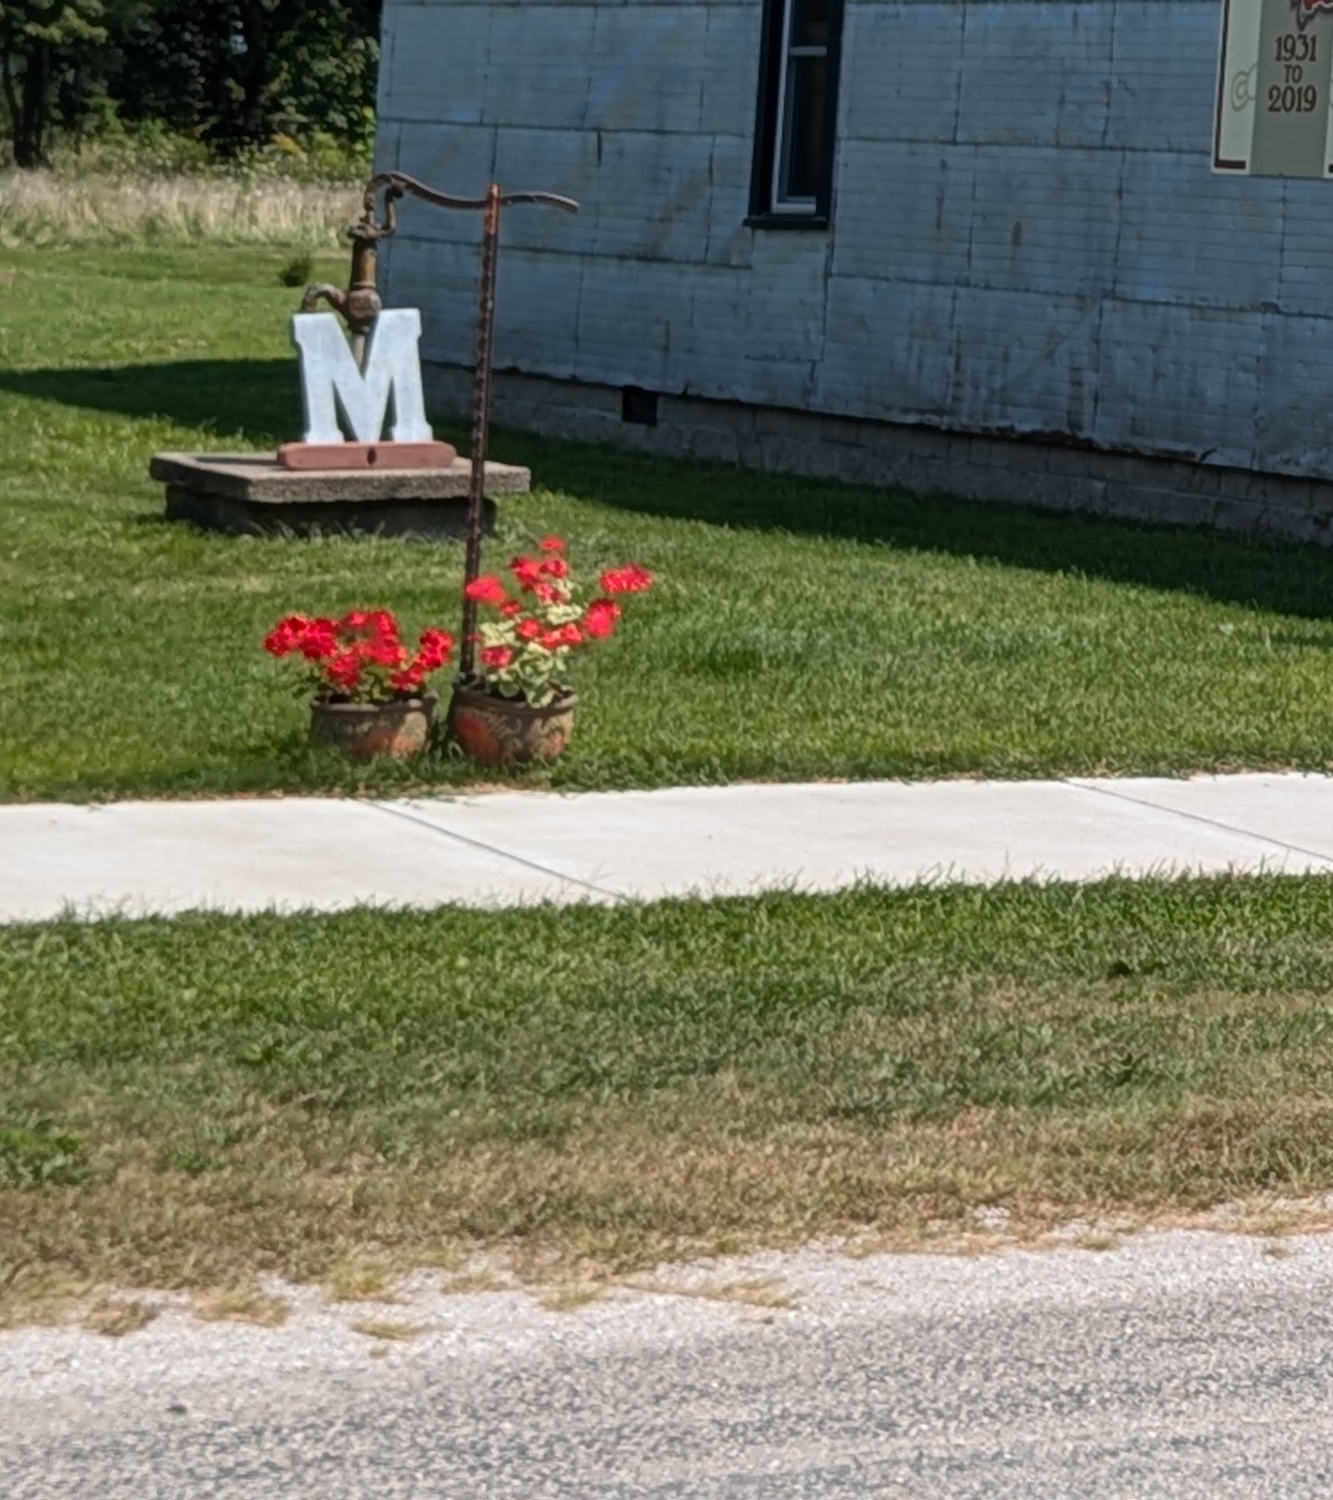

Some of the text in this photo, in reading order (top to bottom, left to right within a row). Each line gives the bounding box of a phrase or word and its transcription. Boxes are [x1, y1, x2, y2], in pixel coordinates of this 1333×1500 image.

[1274, 33, 1318, 63] 1931
[1284, 63, 1304, 85] TO
[1266, 84, 1318, 114] 2019
[293, 308, 434, 444] M
